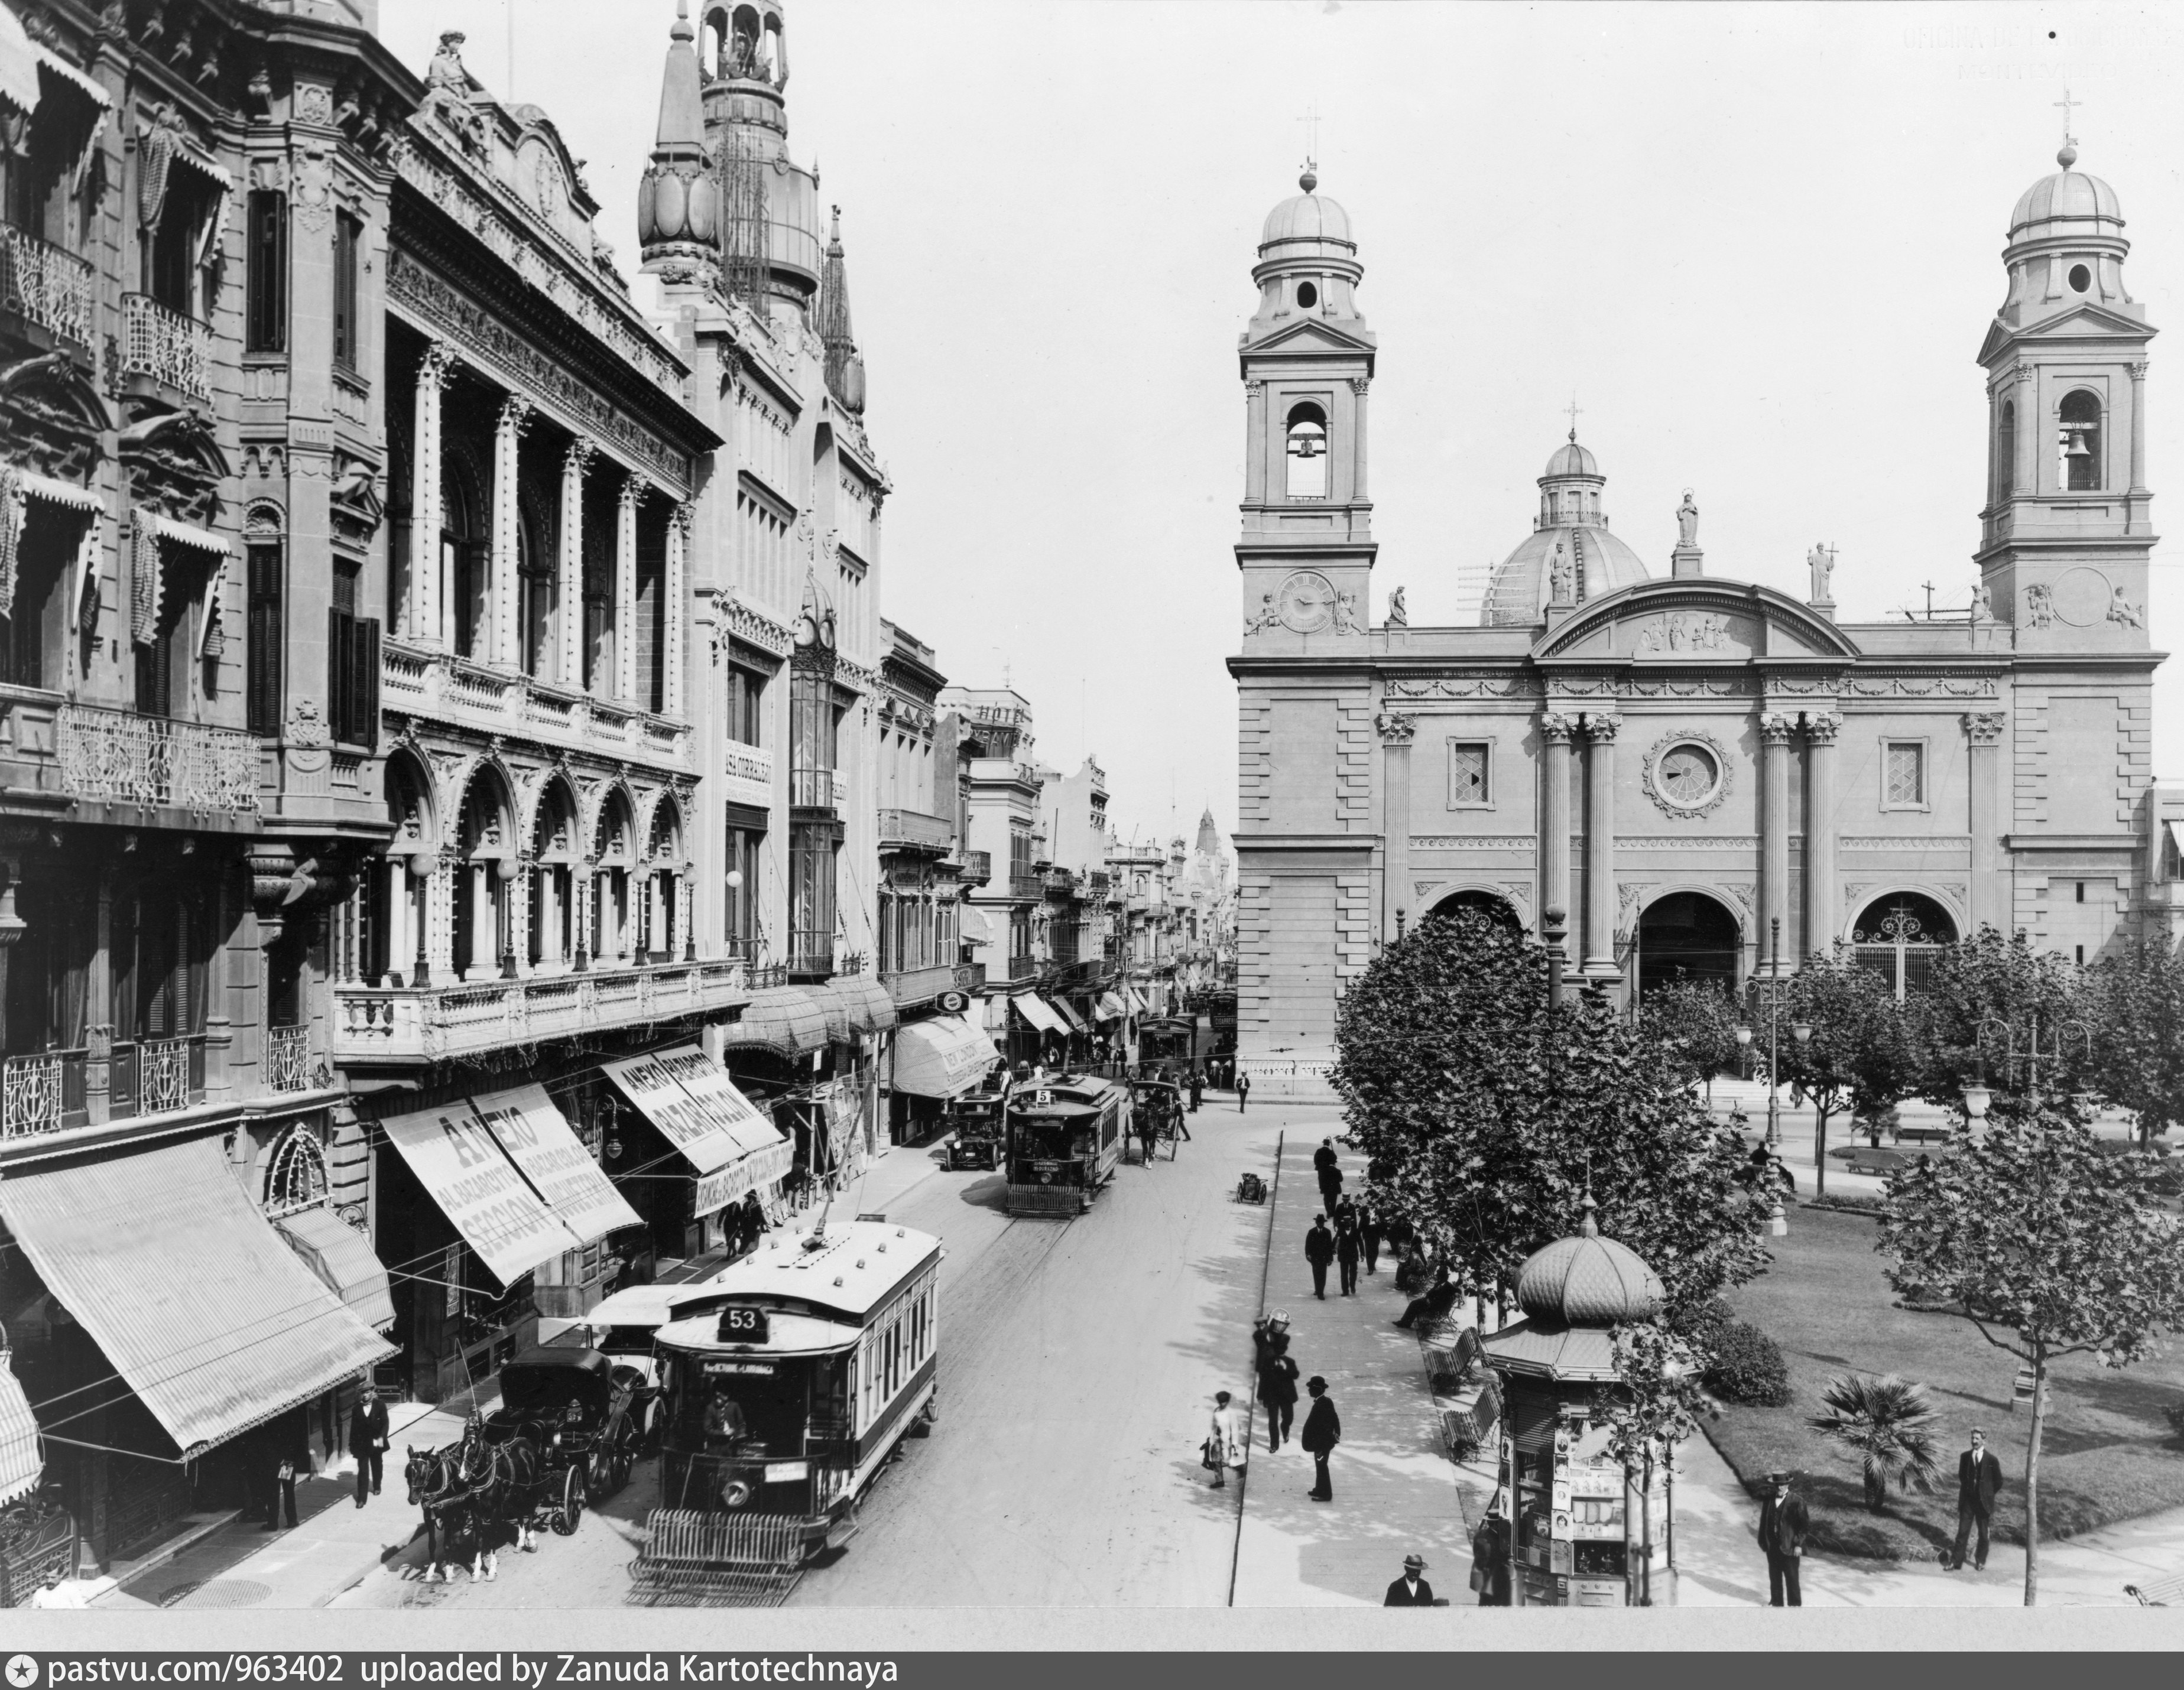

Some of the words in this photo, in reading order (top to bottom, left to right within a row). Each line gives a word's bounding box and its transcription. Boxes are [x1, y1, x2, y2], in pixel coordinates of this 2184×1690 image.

[978, 705, 1025, 723] HOTEL
[621, 1063, 671, 1095] ANEXO
[661, 1052, 719, 1081] BAZARCITO
[1040, 1091, 1046, 1101] 5
[439, 1106, 539, 1169] ANEXO
[653, 1099, 716, 1143] BAZAR
[696, 1088, 754, 1124] COLON
[437, 1187, 463, 1213] AL
[452, 1164, 519, 1205] BAZARCITO
[525, 1150, 565, 1177] BAZAR
[462, 1192, 553, 1258] SECCION
[543, 1170, 621, 1218] JUGUETERIA
[729, 1309, 755, 1328] 53
